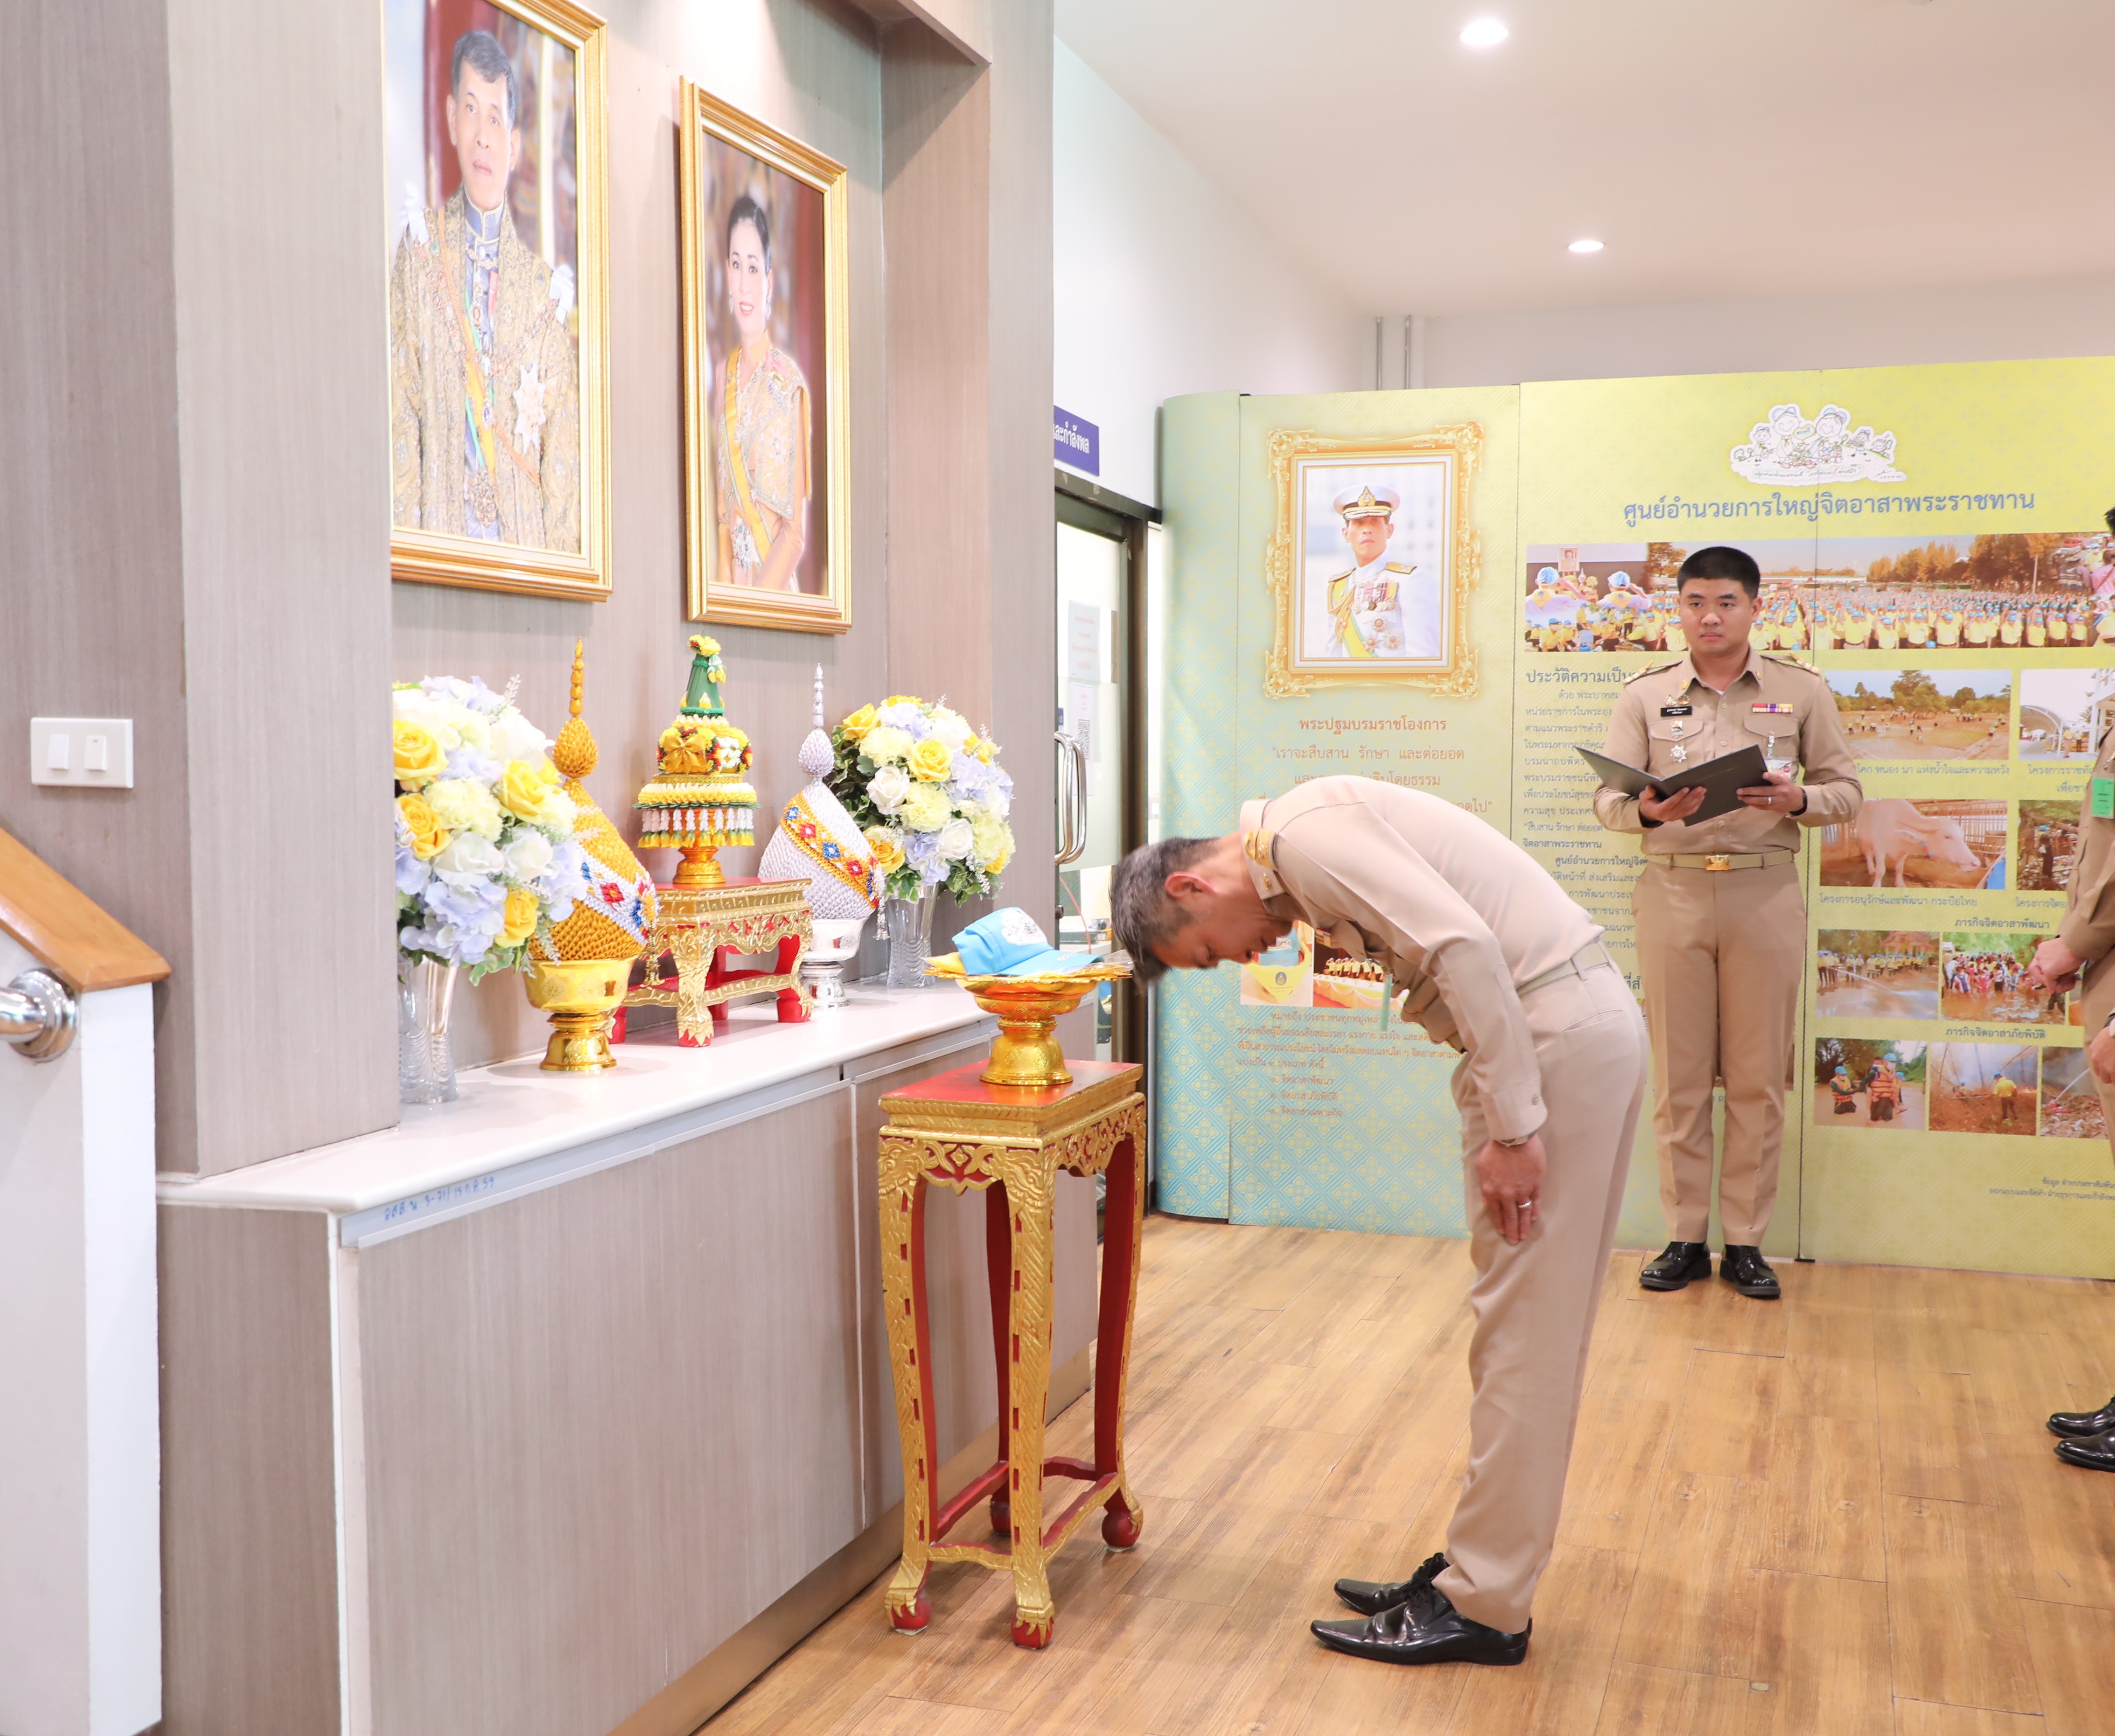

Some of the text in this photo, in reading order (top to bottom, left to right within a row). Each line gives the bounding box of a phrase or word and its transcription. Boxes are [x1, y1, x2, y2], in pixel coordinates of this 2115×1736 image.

[1624, 491, 2035, 527] ศูนย์อำนวยการใหญ่จิตอาสาพระราชทาน
[1526, 666, 1636, 682] ประวัติความเป็
[1299, 715, 1447, 734] พระปฐมบรมราชโองการ
[1358, 745, 1389, 760] รักษา
[1399, 746, 1464, 760] และต่อยอด
[1916, 761, 2010, 774] แห่งน้ำใจและความหวัง
[1523, 807, 1555, 817] ความสุข
[1523, 838, 1602, 848] จิตอาสาพระราชทาน
[1931, 895, 1977, 906] กระบือไทย
[1583, 907, 1634, 915] ะชาชนจาก
[1955, 916, 2050, 929] ภารกิจจิตอาสาพัฒนา
[1945, 1026, 2047, 1039] ภารกิจจิตอาสาภัยพิบัติ
